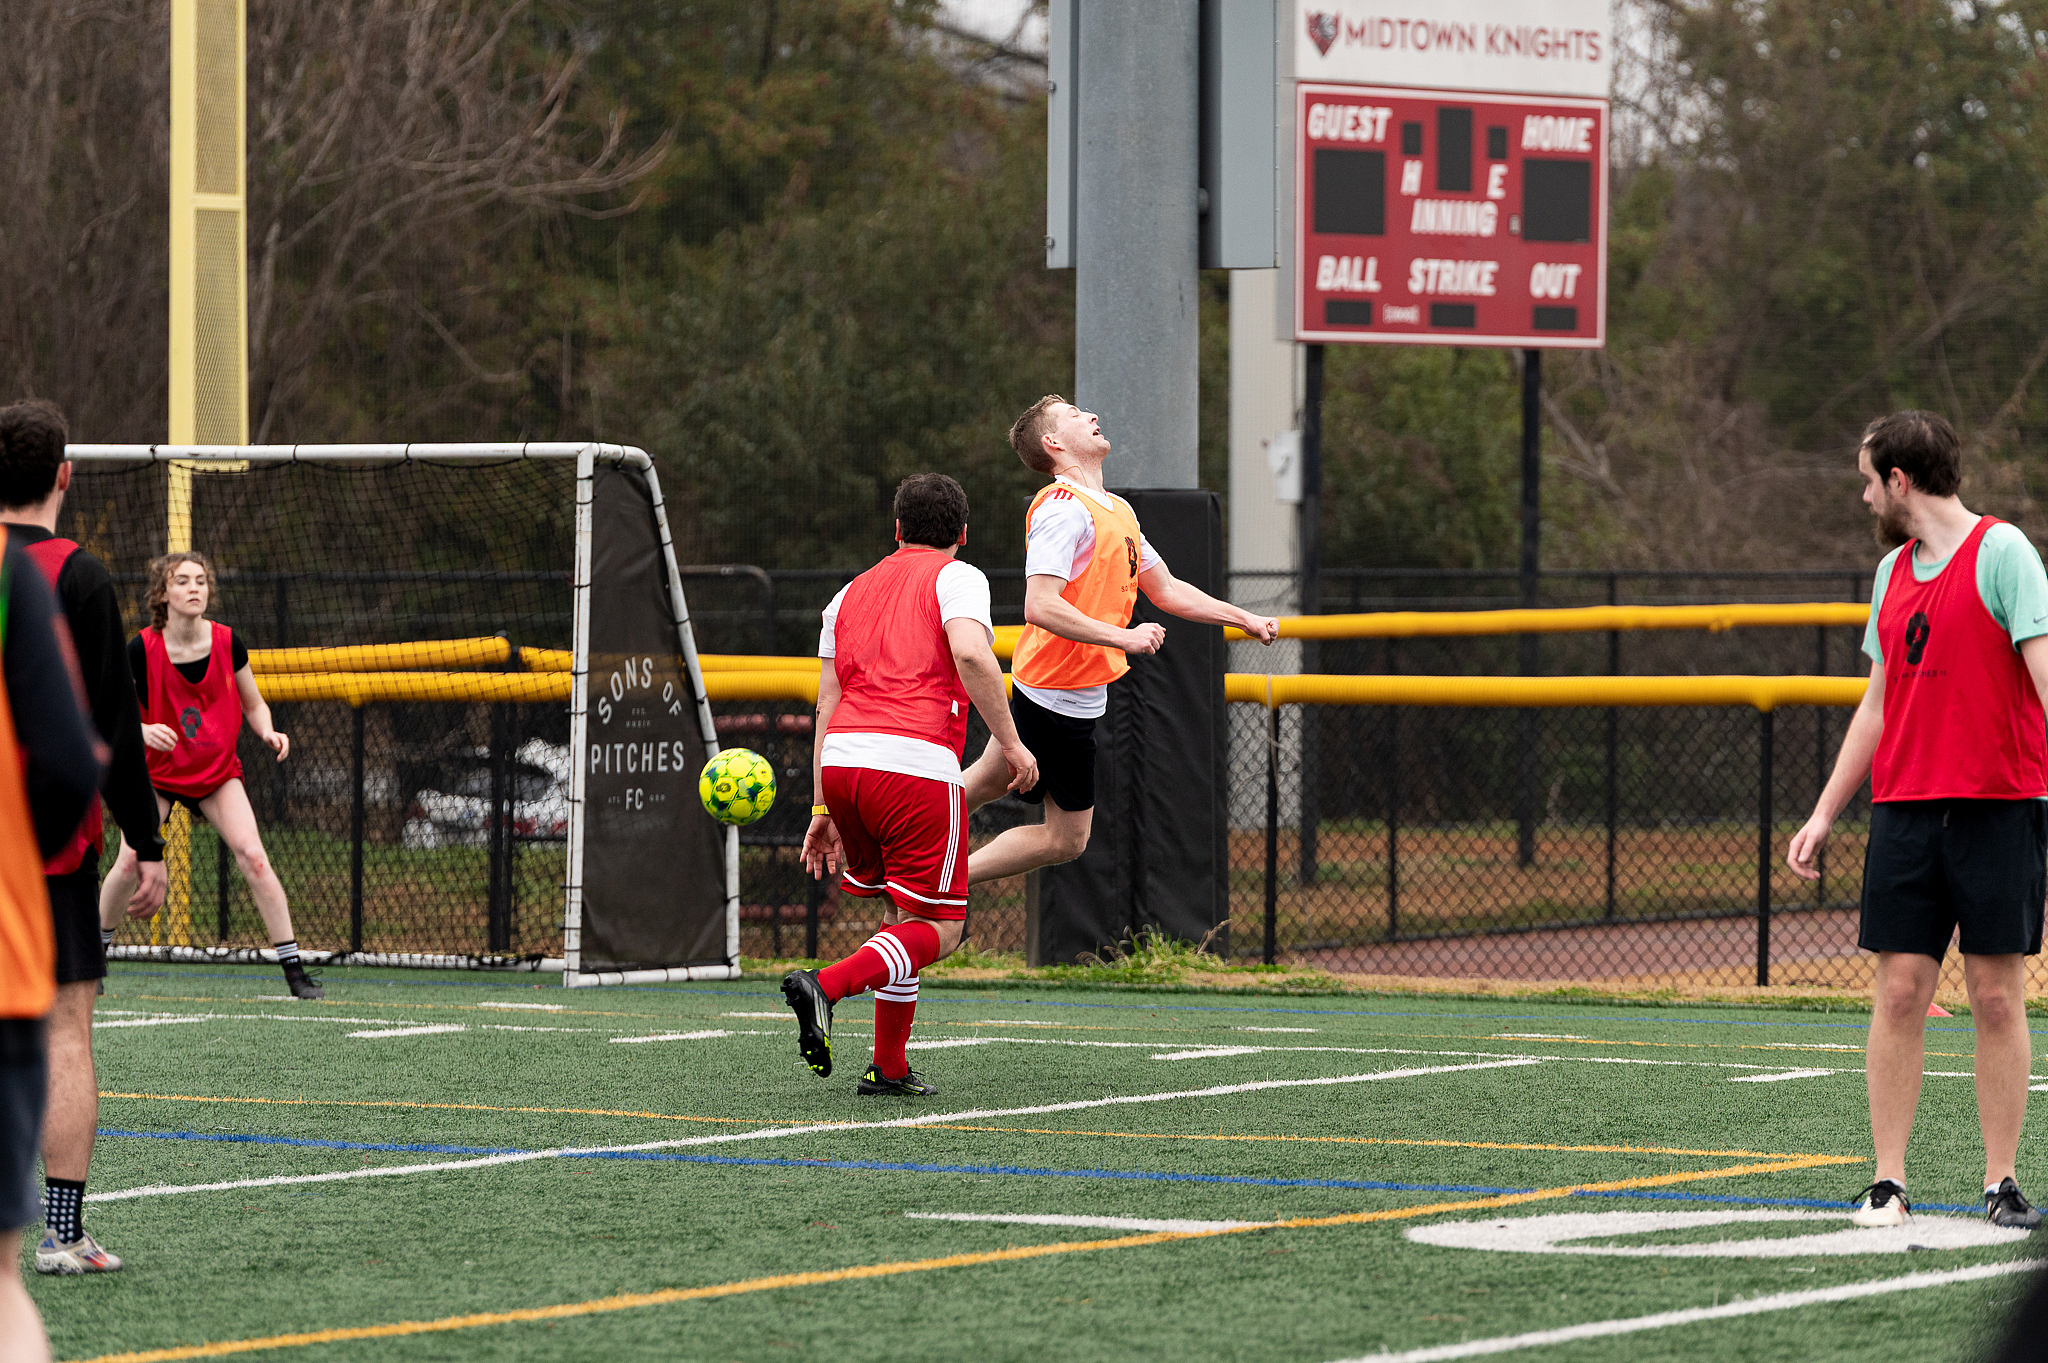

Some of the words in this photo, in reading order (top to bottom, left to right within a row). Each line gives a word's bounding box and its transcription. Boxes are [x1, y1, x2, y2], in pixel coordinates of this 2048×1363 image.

[1345, 17, 1477, 53] MIDTOWN
[1485, 24, 1602, 62] KNIGHTS
[1307, 103, 1393, 142] GUEST
[1522, 115, 1595, 152] HOME
[1401, 160, 1423, 195] H
[1487, 163, 1508, 199] E
[1410, 199, 1498, 237] INNING
[1316, 255, 1382, 293] BALL
[1408, 257, 1499, 296] STRIKE
[1530, 262, 1581, 298] OUT
[598, 656, 653, 725] SONS
[662, 681, 682, 716] OF
[591, 740, 685, 774] PITCHES
[625, 787, 644, 811] FC
